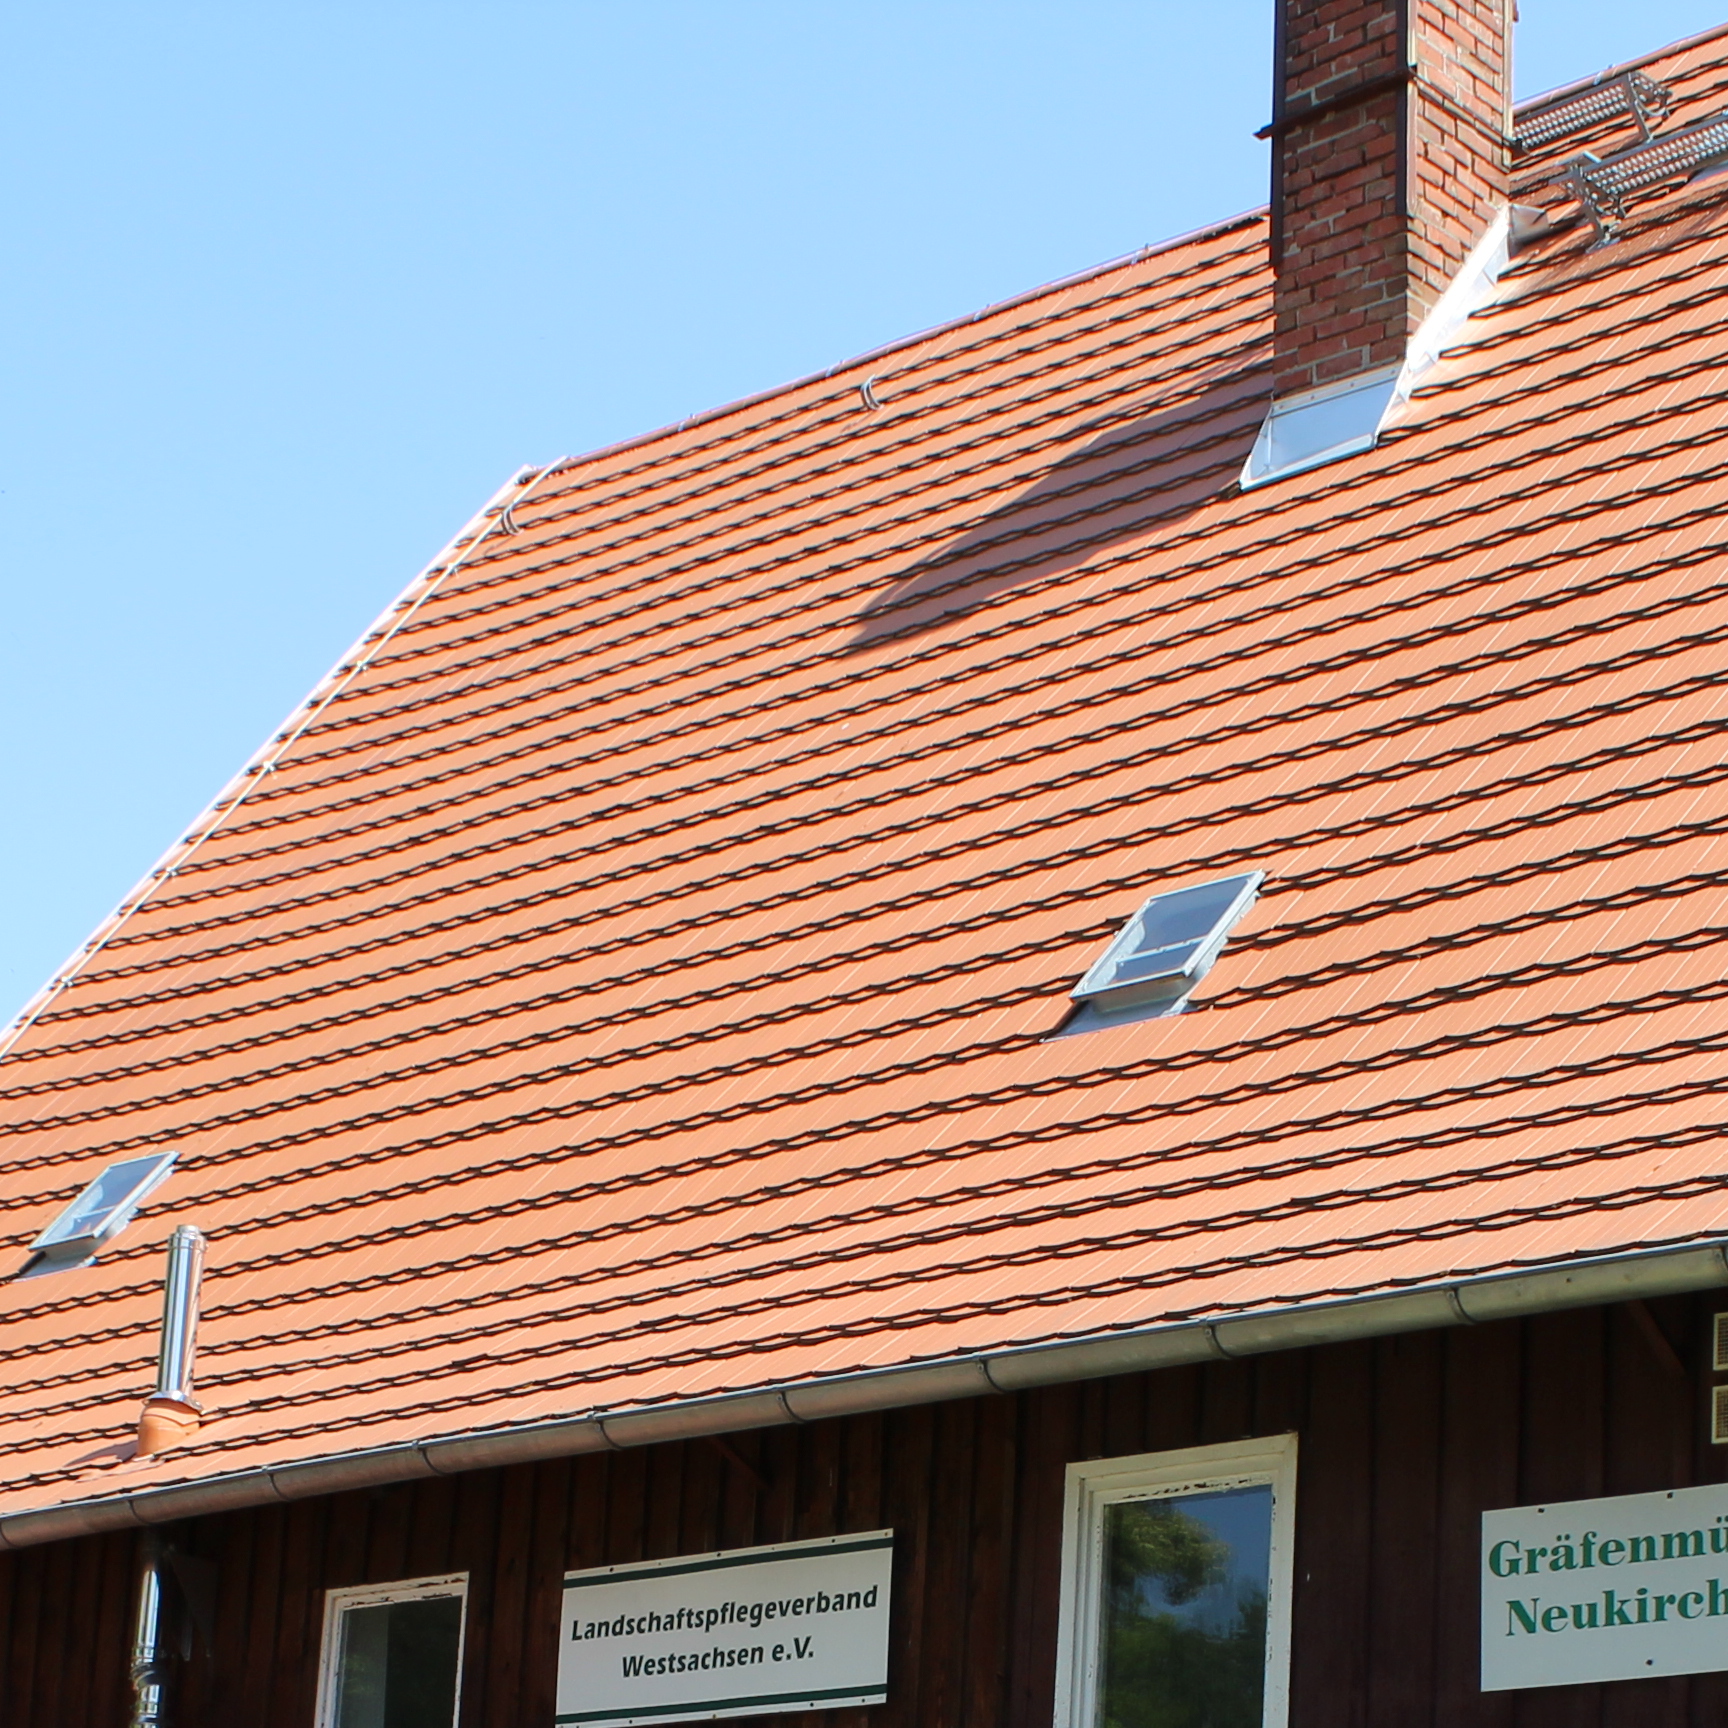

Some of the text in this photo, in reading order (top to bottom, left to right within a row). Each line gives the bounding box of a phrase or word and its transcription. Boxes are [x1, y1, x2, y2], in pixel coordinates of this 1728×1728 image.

[570, 1584, 879, 1642] Landschaftspflegeverband
[621, 1635, 815, 1679] Westsachsen e.V.
